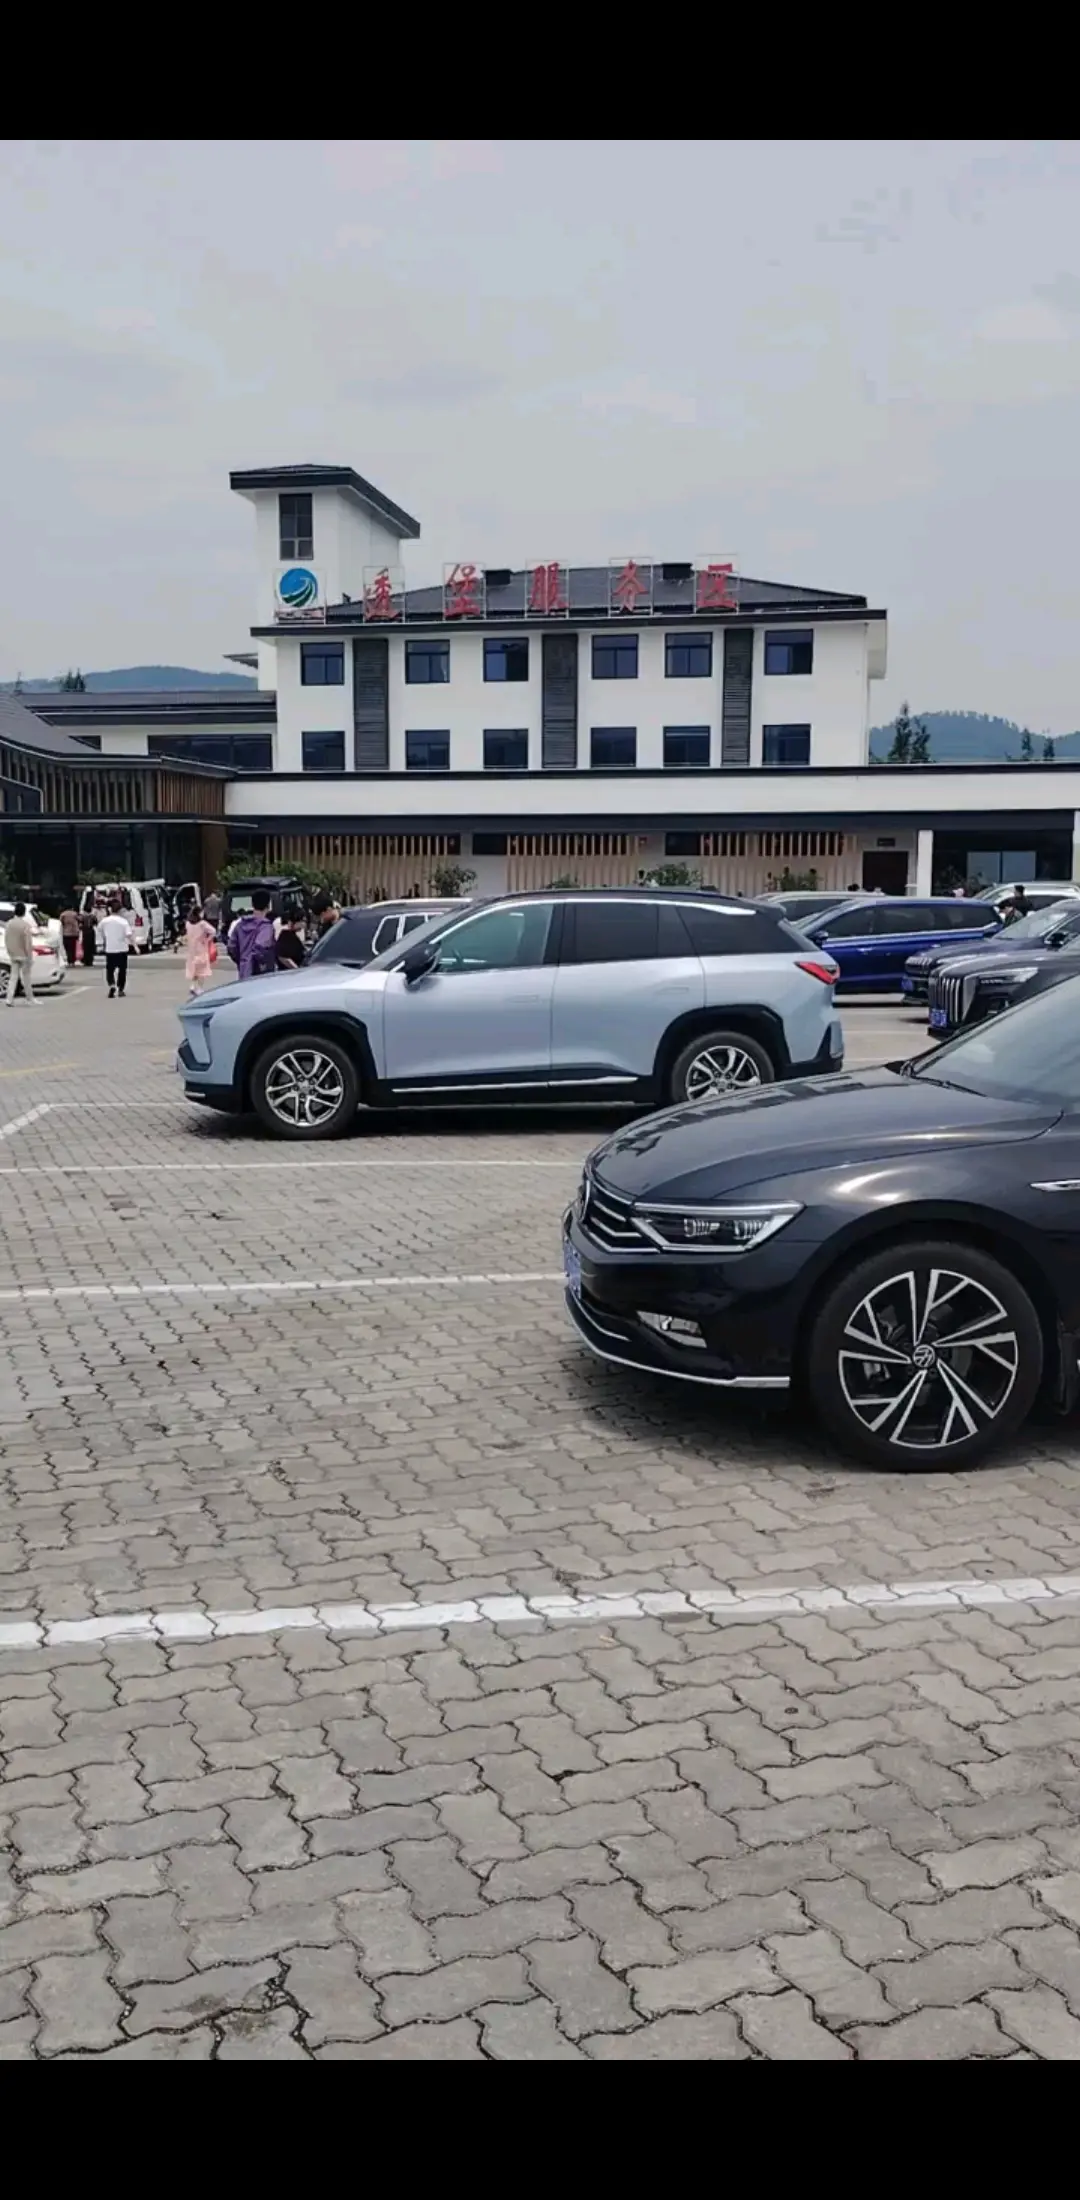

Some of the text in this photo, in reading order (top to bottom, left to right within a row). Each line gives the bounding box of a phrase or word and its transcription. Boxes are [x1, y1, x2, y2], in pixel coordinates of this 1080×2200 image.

[364, 558, 738, 621] 透堡服务区
